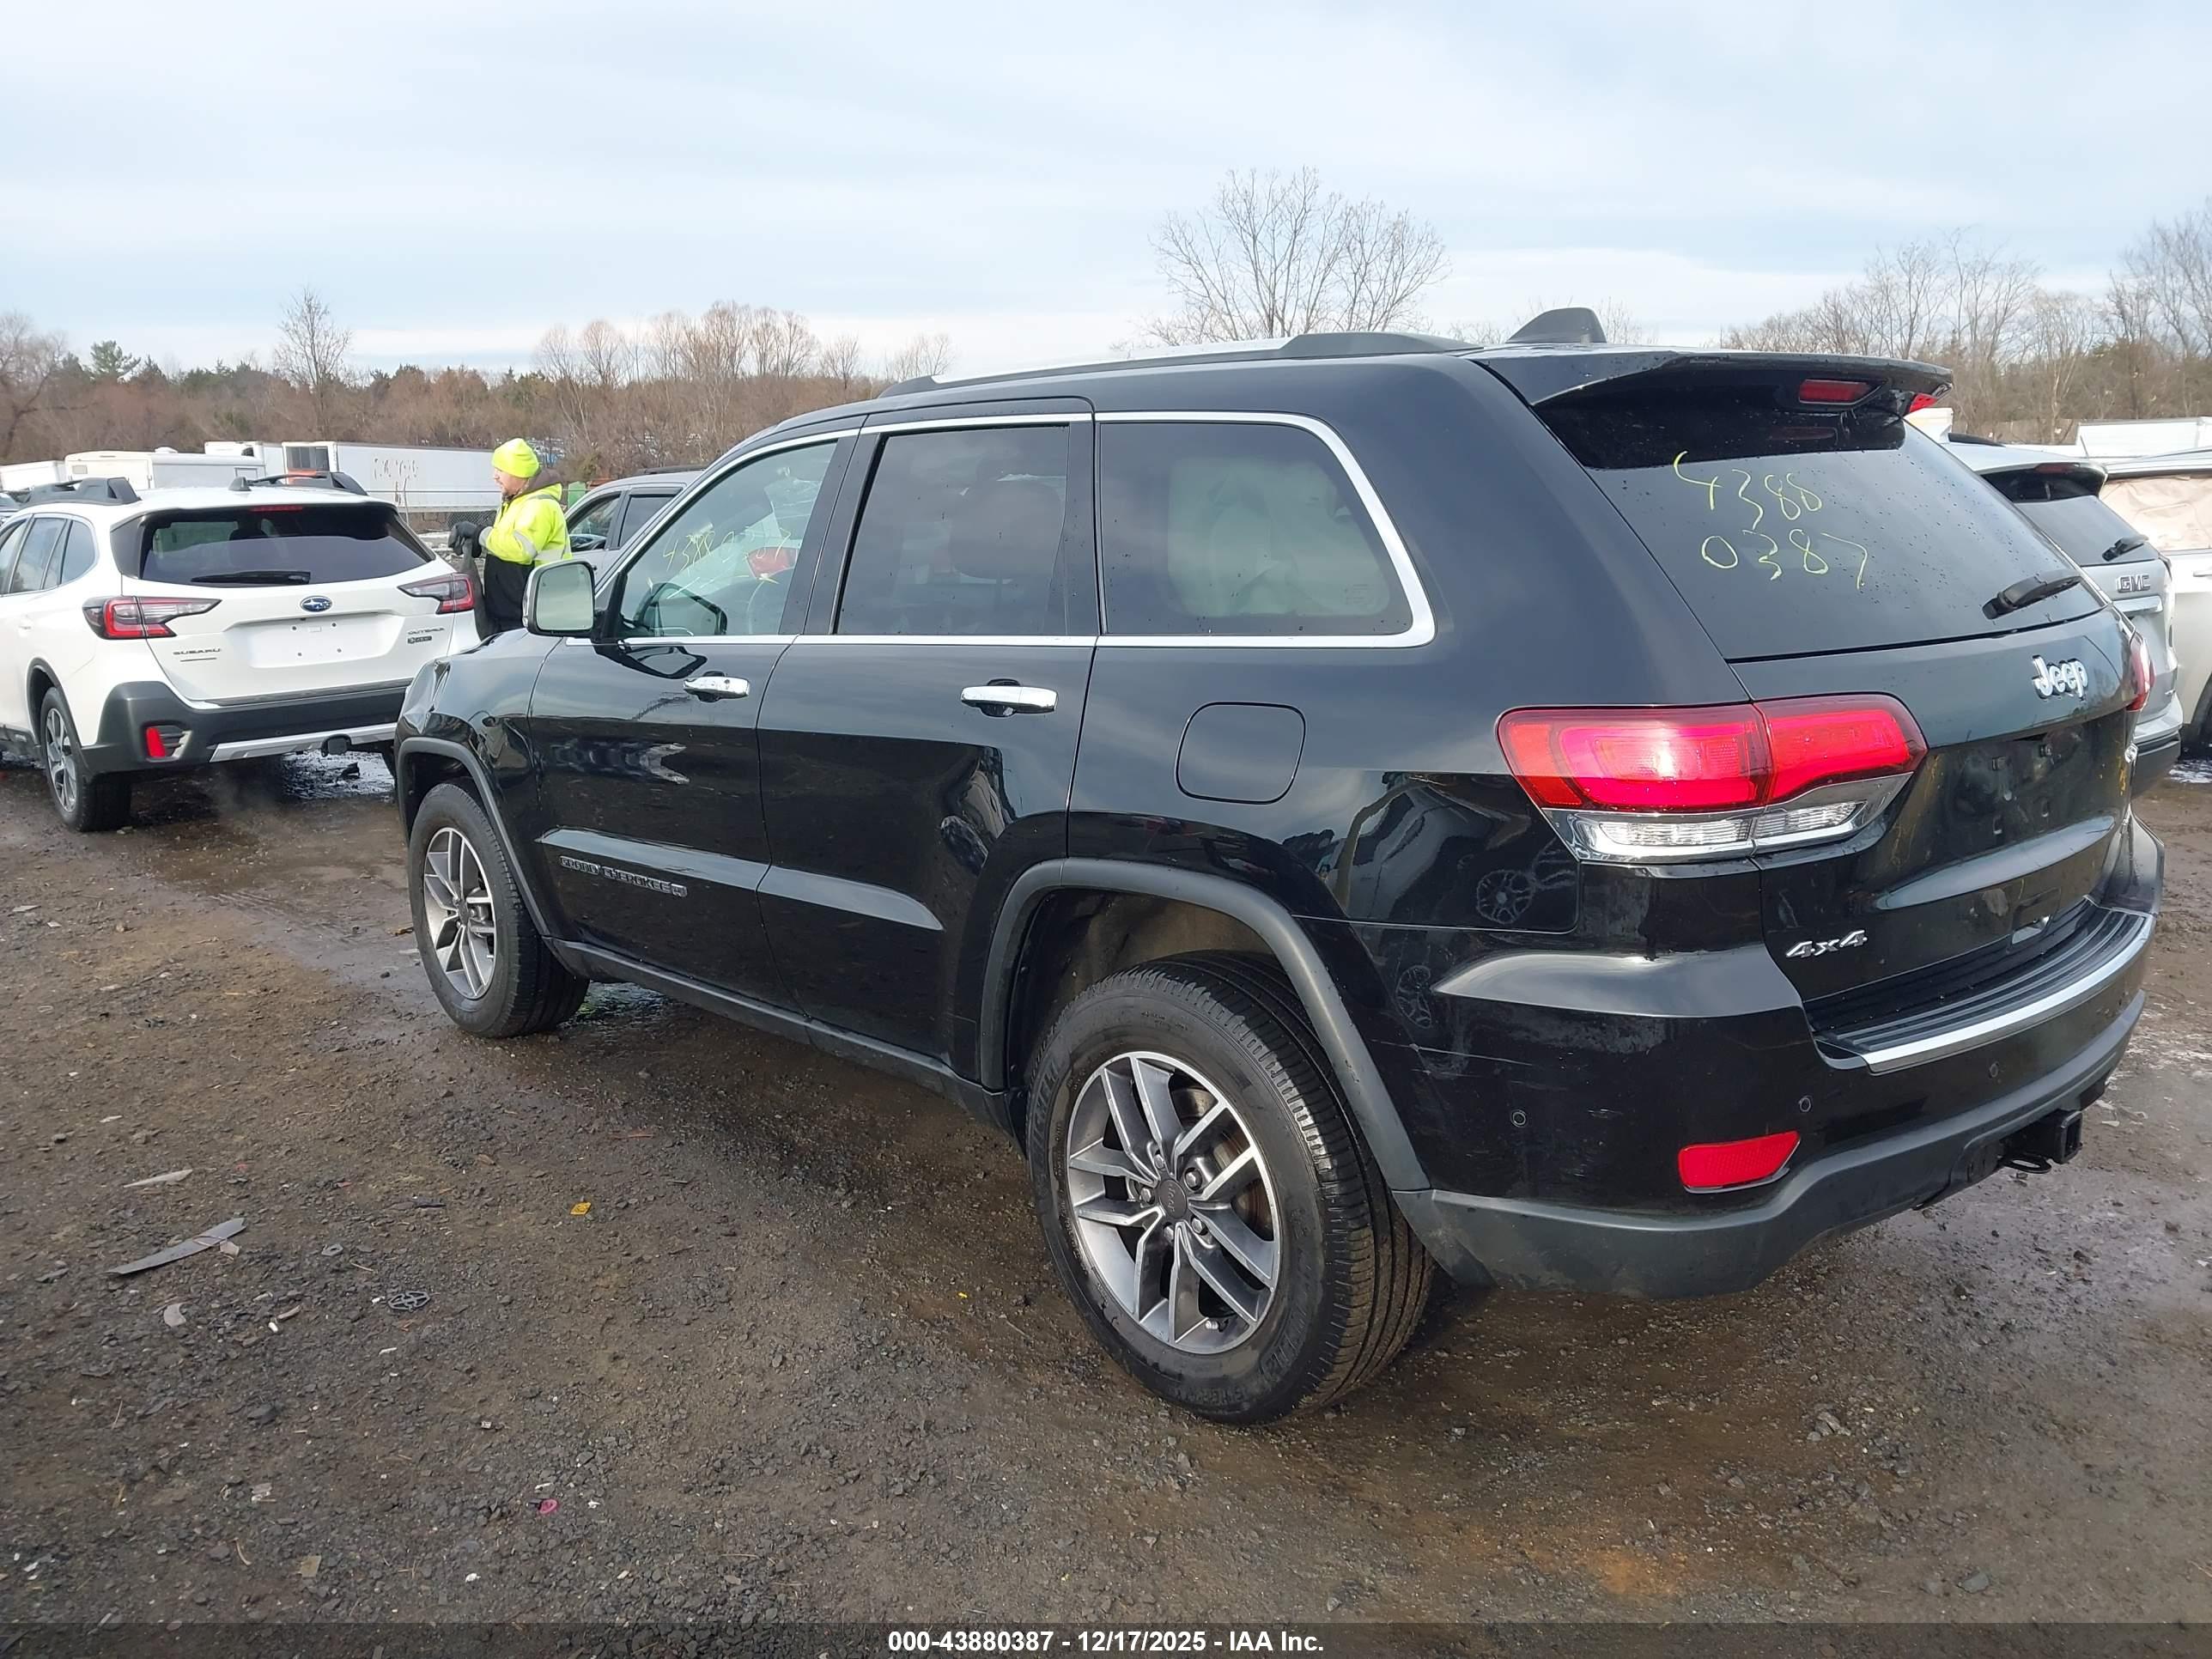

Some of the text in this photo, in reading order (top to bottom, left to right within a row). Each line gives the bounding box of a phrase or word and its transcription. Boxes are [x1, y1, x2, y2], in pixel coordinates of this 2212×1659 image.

[1674, 451, 1822, 530] 4388
[1701, 529, 1867, 590] 0387
[2118, 574, 2151, 592] GMC
[2032, 655, 2088, 701] Jeep
[560, 855, 672, 894] GRAND CHEROKEE
[1786, 930, 1868, 958] 4x4
